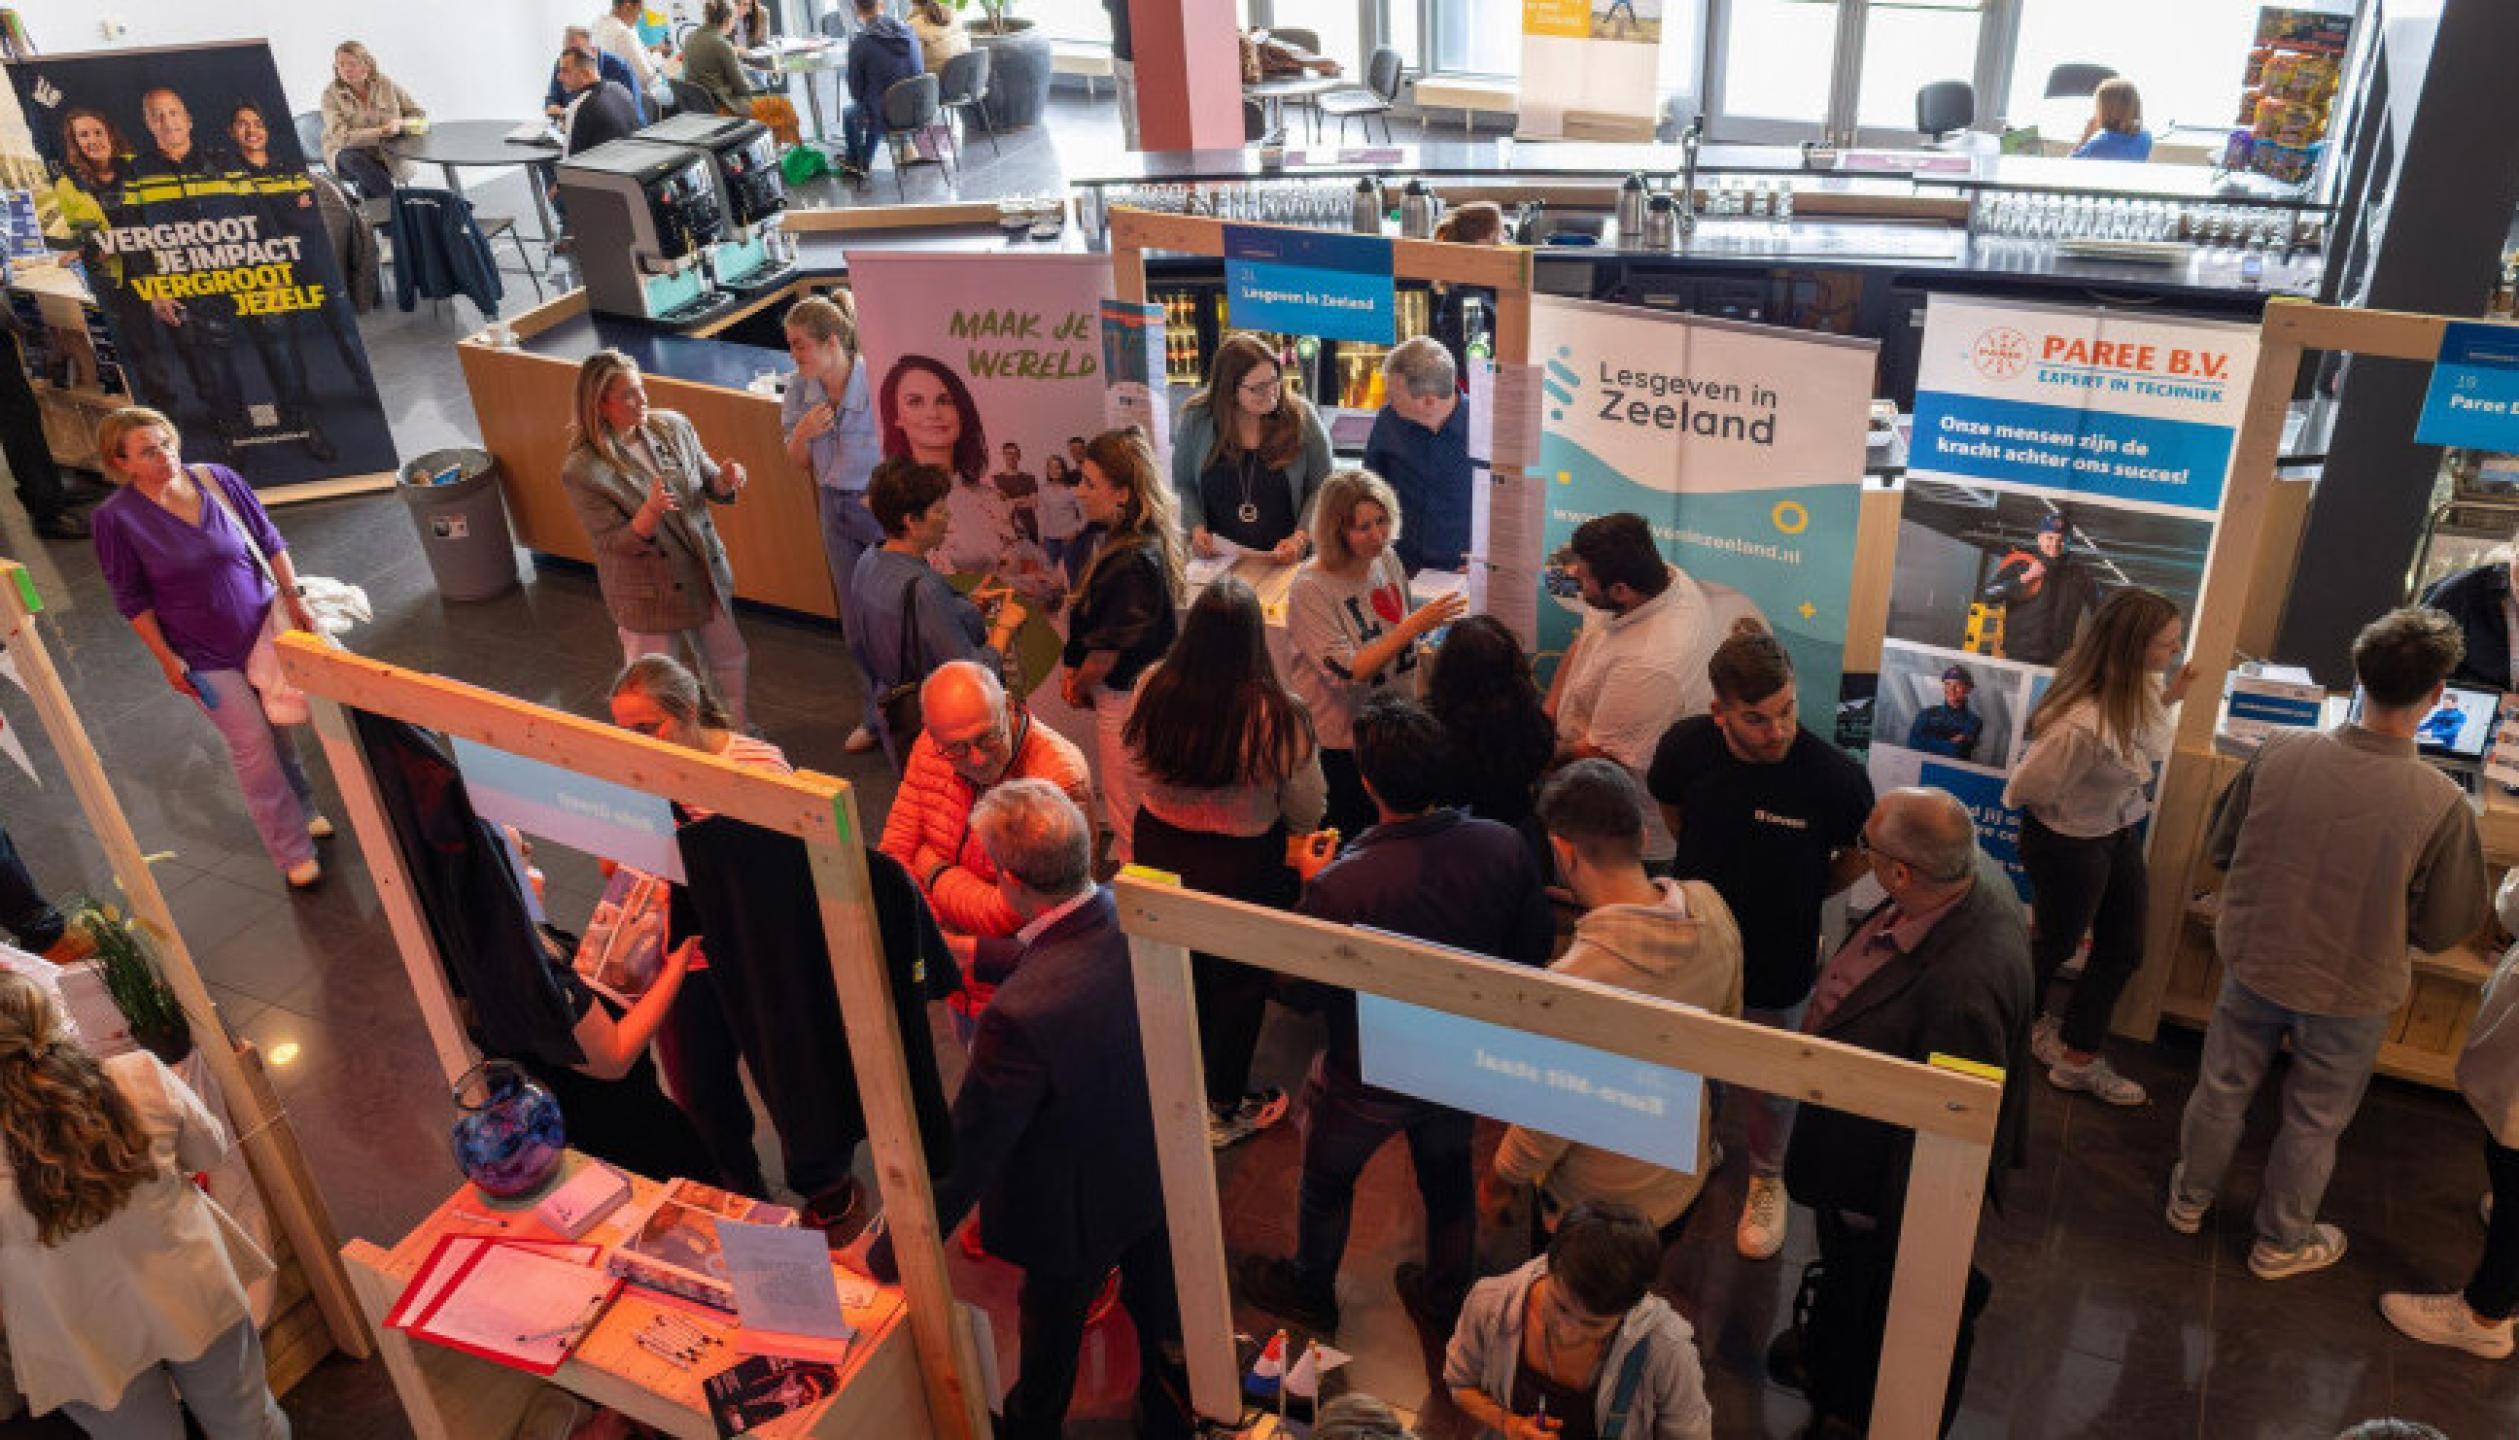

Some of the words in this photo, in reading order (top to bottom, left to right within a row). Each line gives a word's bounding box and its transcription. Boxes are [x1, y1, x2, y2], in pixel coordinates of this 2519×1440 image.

[93, 215, 258, 254] VERGROOT
[154, 249, 189, 275] JE
[187, 236, 301, 269] IMPACT
[130, 262, 293, 301] VERGROOT
[231, 284, 326, 316] JEZELF
[1241, 285, 1304, 304] Lesgeven
[1306, 290, 1319, 304] in
[1321, 293, 1375, 311] Zeeland
[950, 308, 1041, 341] MAAK
[1053, 310, 1094, 341] JE
[967, 349, 1097, 380] WERELD
[2042, 335, 2154, 372] PAREE
[2168, 348, 2230, 379] B.V.
[1599, 360, 1741, 404] Lesgeven
[1751, 382, 1777, 409] in
[2037, 369, 2104, 390] EXPERT
[2110, 373, 2129, 392] IN
[2135, 379, 2224, 403] TECHNIEK
[2450, 393, 2505, 414] Paree
[1598, 388, 1776, 446] Zeeland
[1940, 415, 1991, 437] Onze
[1996, 426, 2074, 447] mensen
[2079, 432, 2117, 456] zijn
[2122, 438, 2149, 457] de
[1936, 436, 2001, 460] kracht
[2005, 446, 2070, 470] achter
[2073, 456, 2109, 473] ons
[2113, 462, 2189, 485] succes!
